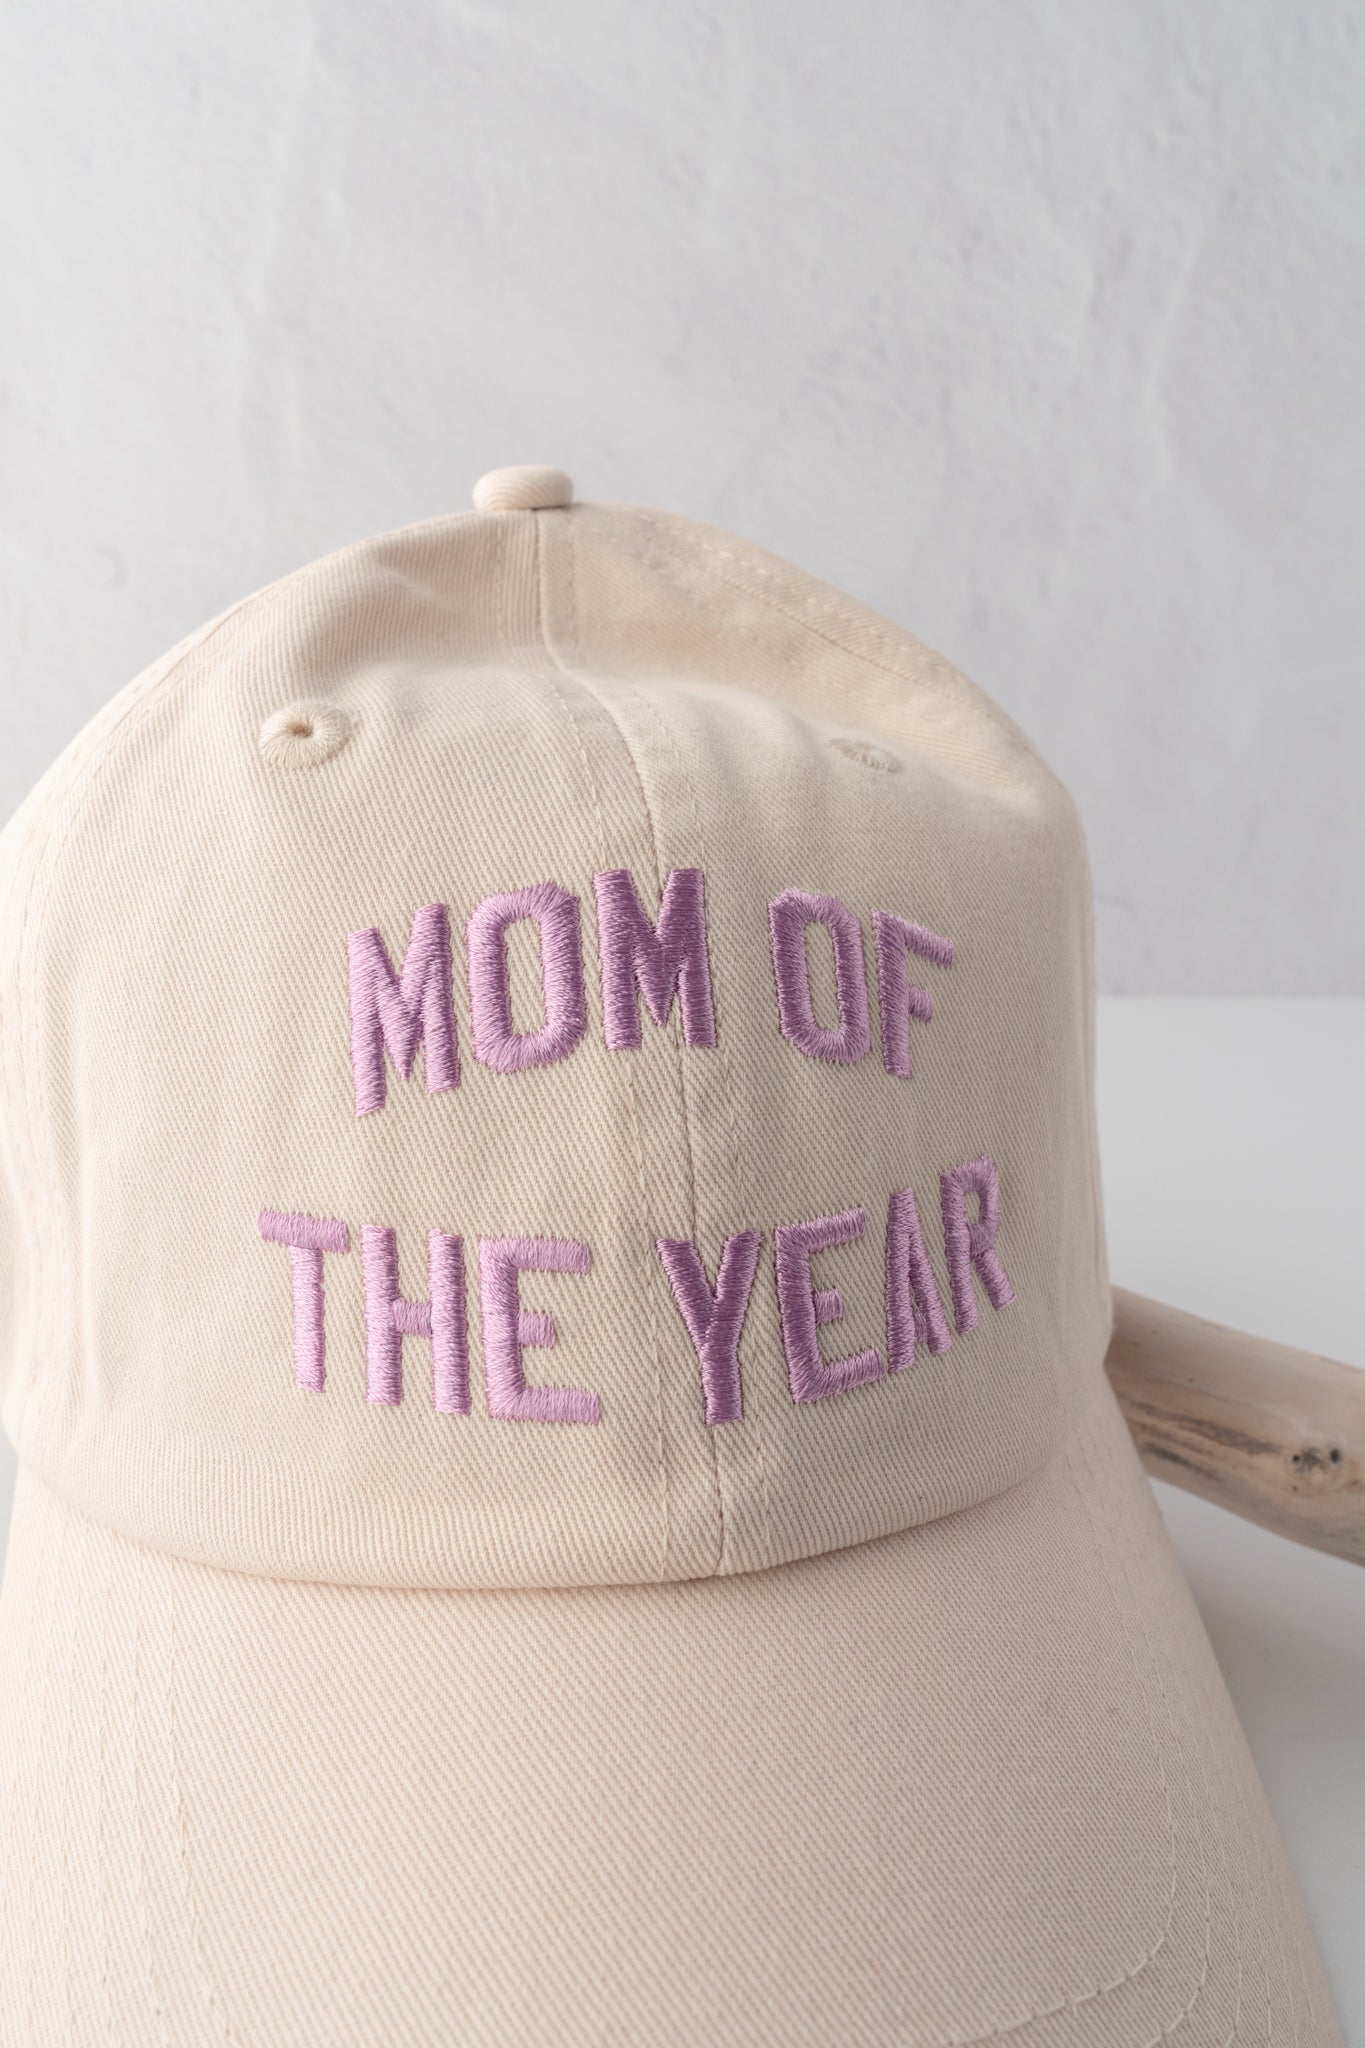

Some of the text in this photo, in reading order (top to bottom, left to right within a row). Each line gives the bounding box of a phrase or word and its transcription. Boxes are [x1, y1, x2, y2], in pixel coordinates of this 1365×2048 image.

[346, 868, 954, 1117] MOM OF
[257, 1156, 1015, 1426] THE YEAR
